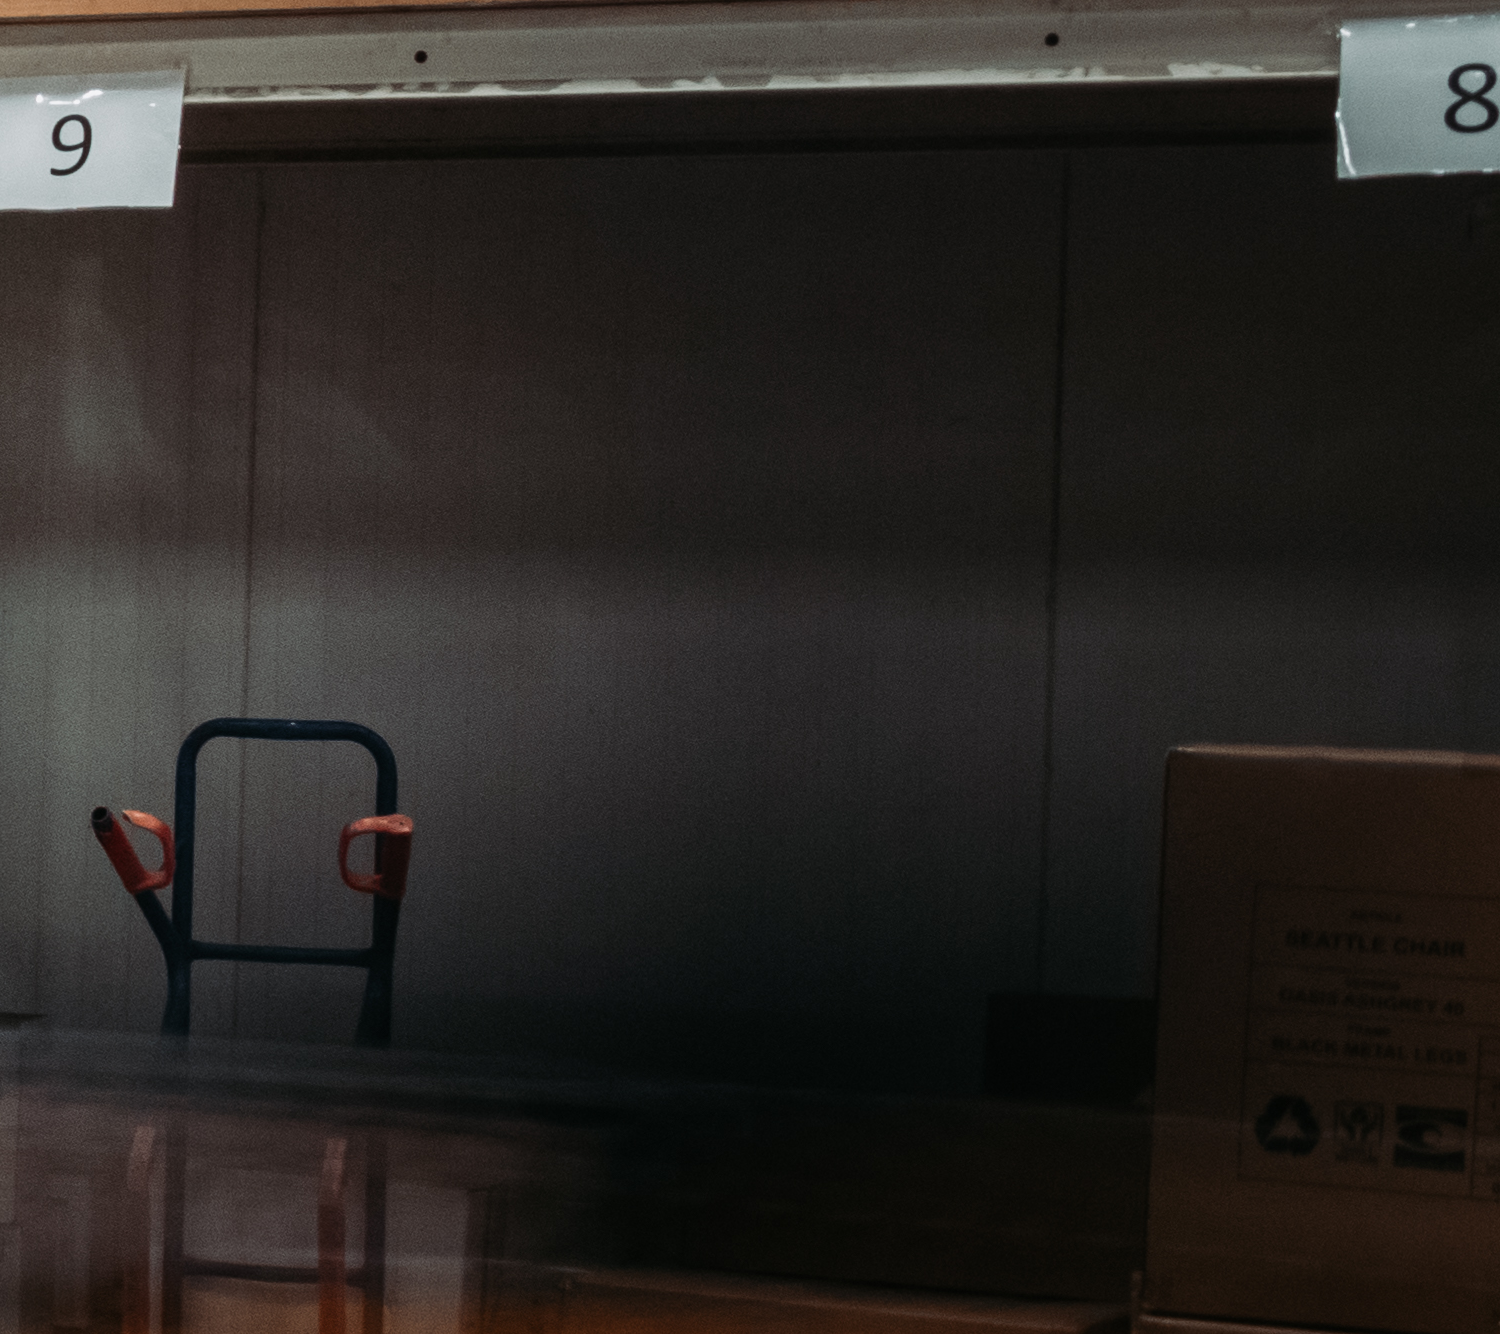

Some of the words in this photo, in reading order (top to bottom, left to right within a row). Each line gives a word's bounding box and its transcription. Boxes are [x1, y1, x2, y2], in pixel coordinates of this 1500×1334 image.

[1444, 63, 1500, 134] 8
[49, 114, 93, 177] 9
[1285, 929, 1385, 953] SEATTLE
[1393, 937, 1466, 957] CHAIR
[1272, 1037, 1337, 1055] BLACK
[1344, 1042, 1406, 1060] METAL
